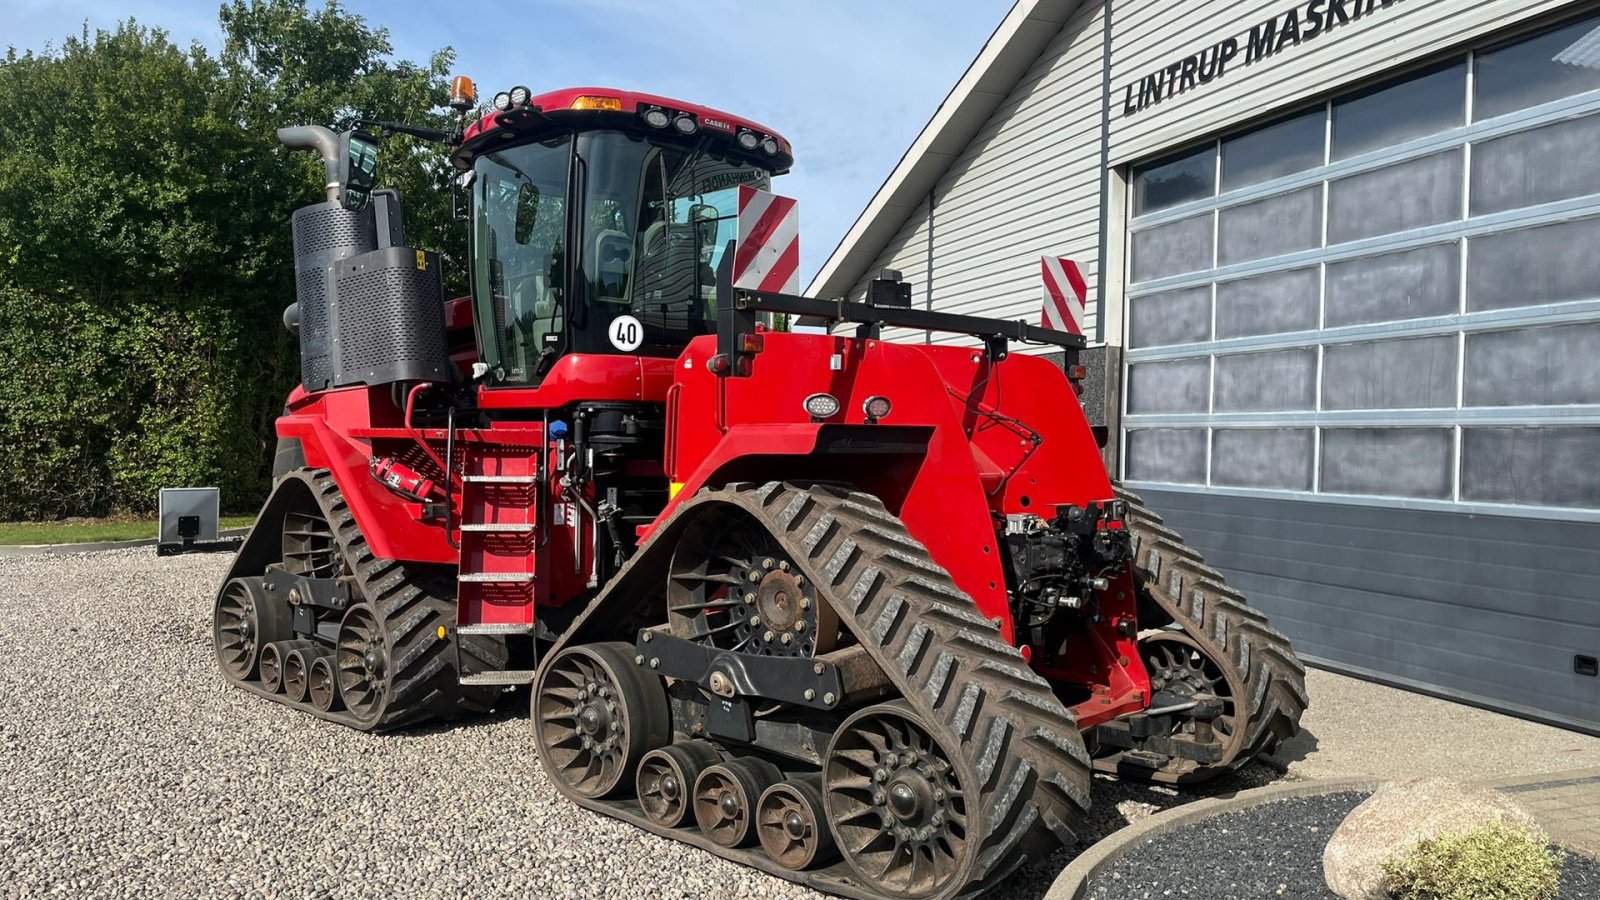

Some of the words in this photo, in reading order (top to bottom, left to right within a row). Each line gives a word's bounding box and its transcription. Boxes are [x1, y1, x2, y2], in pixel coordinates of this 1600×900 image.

[1123, 37, 1238, 116] LINTRUP
[1244, 0, 1397, 65] MASK
[616, 322, 637, 344] 40
